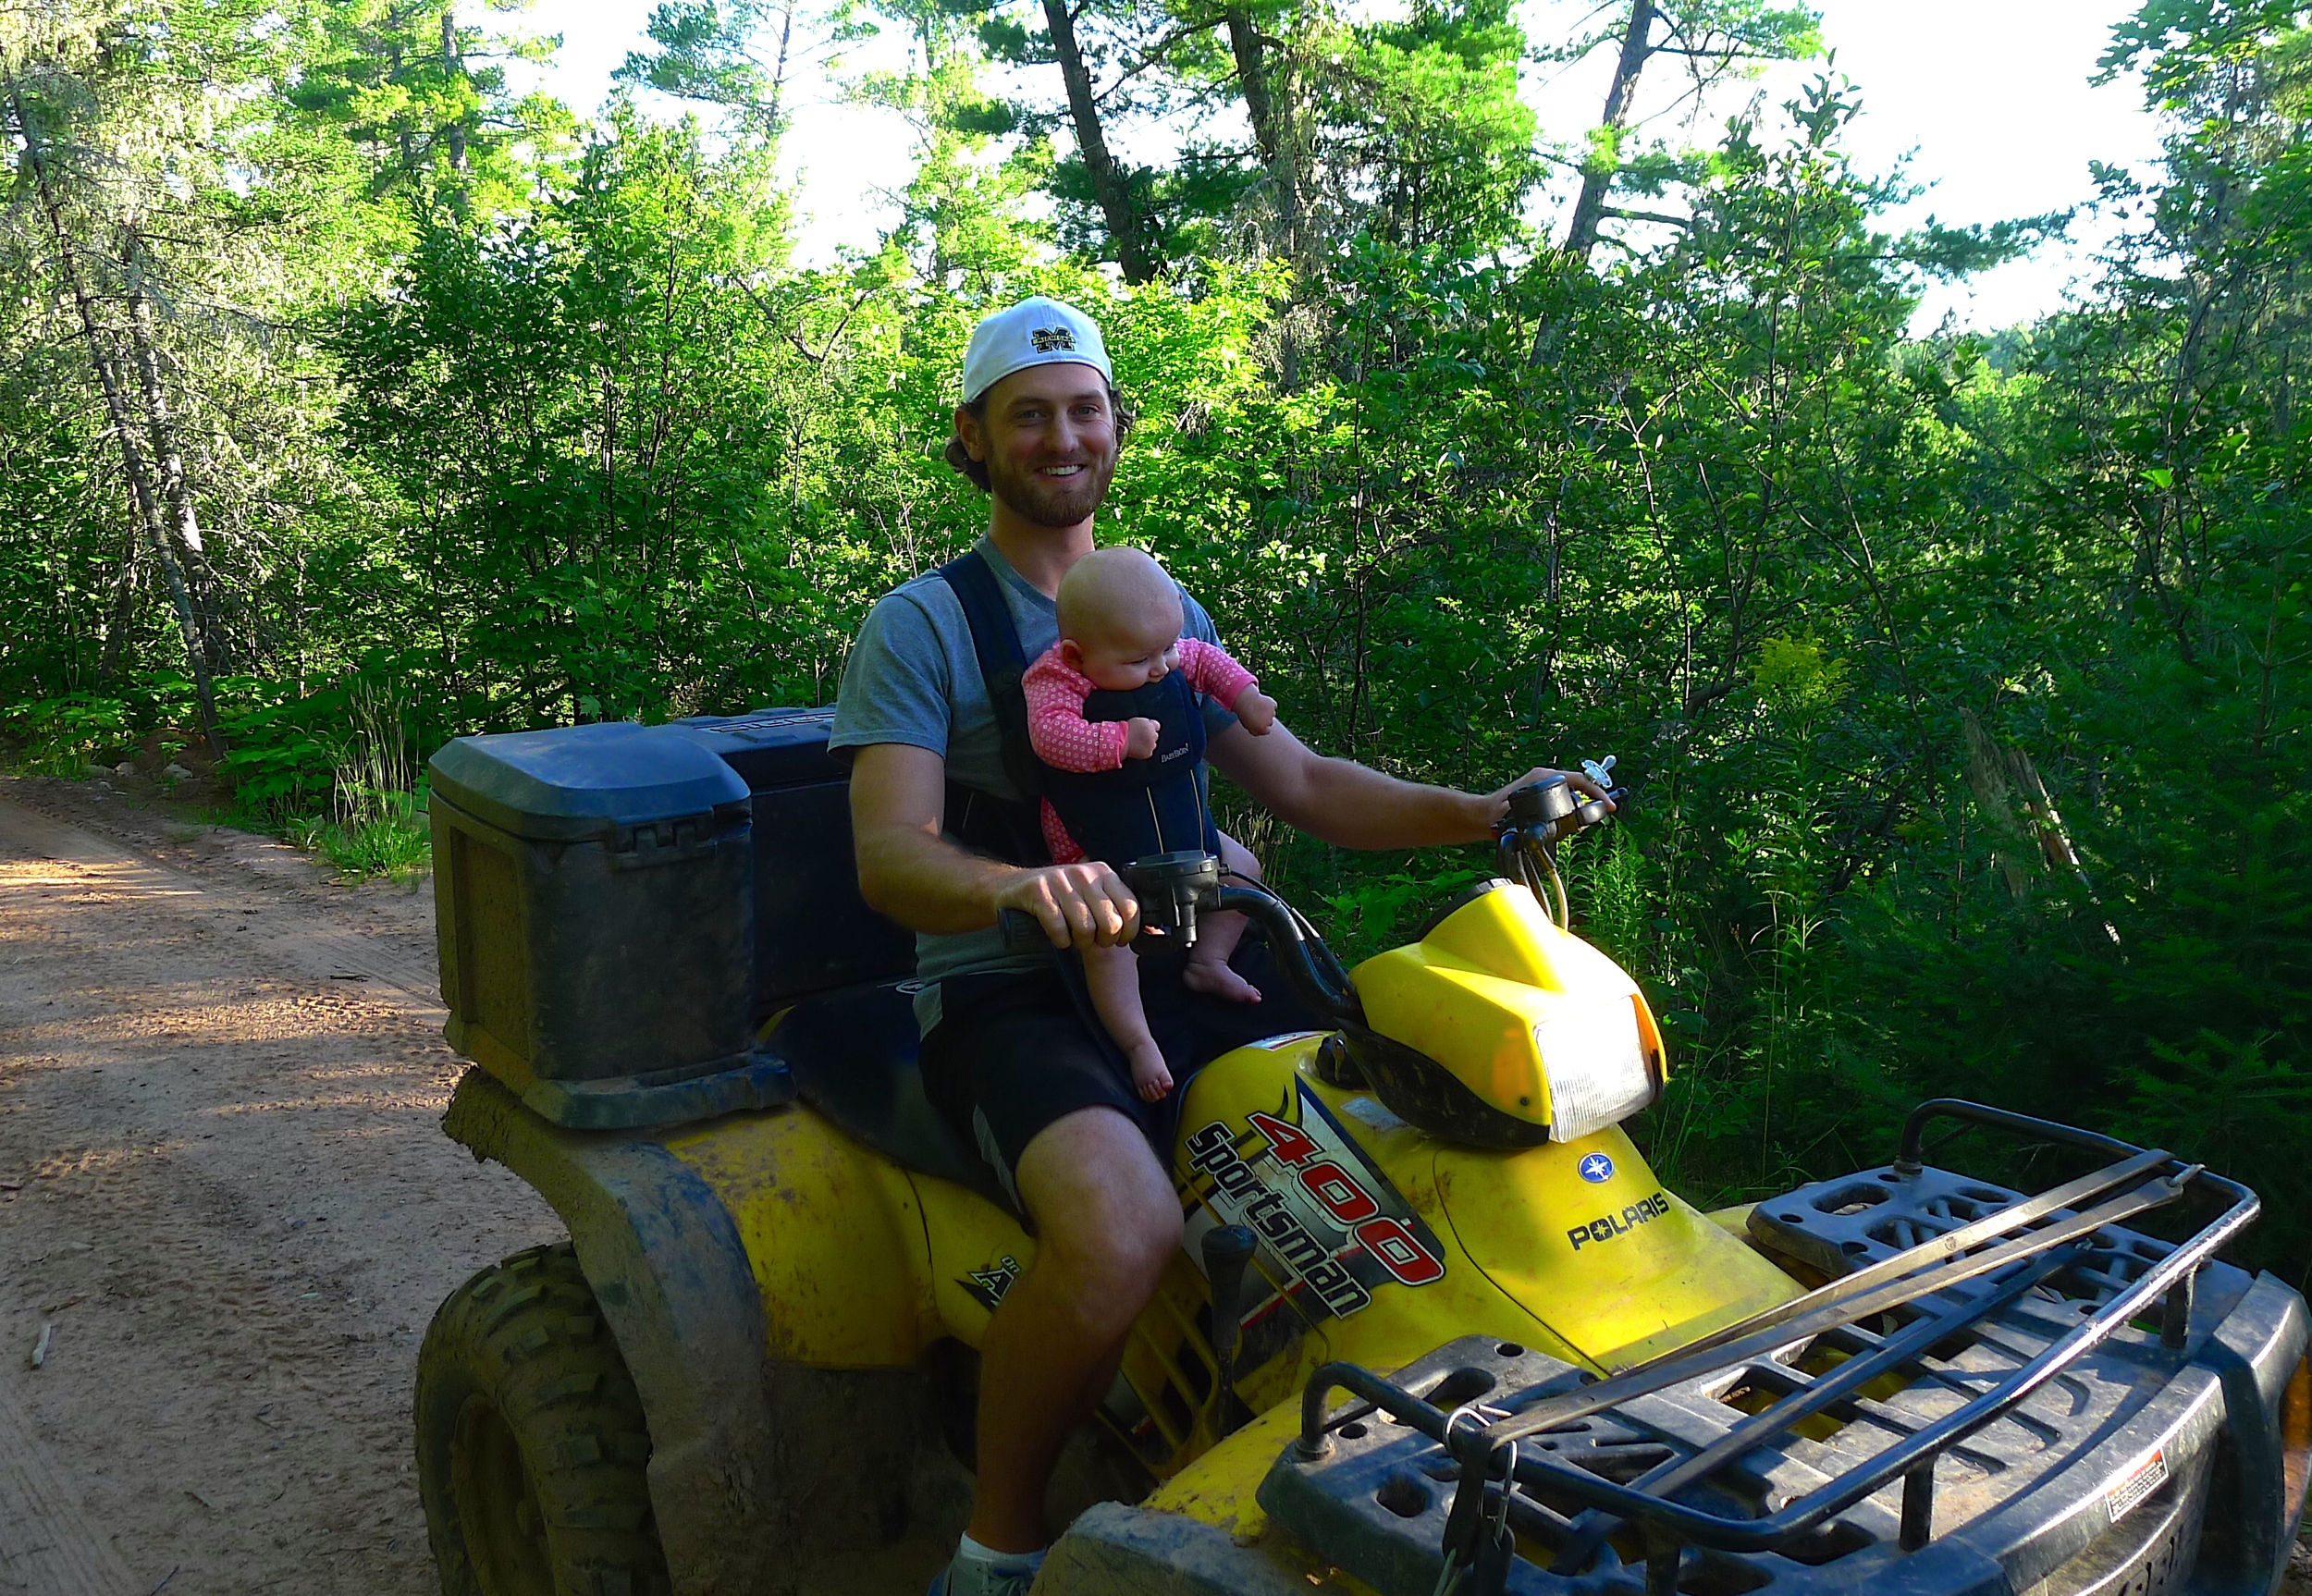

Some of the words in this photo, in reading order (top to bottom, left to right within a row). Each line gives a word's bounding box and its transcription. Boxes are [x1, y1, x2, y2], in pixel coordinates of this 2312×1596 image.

[1185, 1120, 1371, 1320] Sportsman
[1246, 1110, 1446, 1286] 400
[1567, 1192, 1670, 1251] POLARIS
